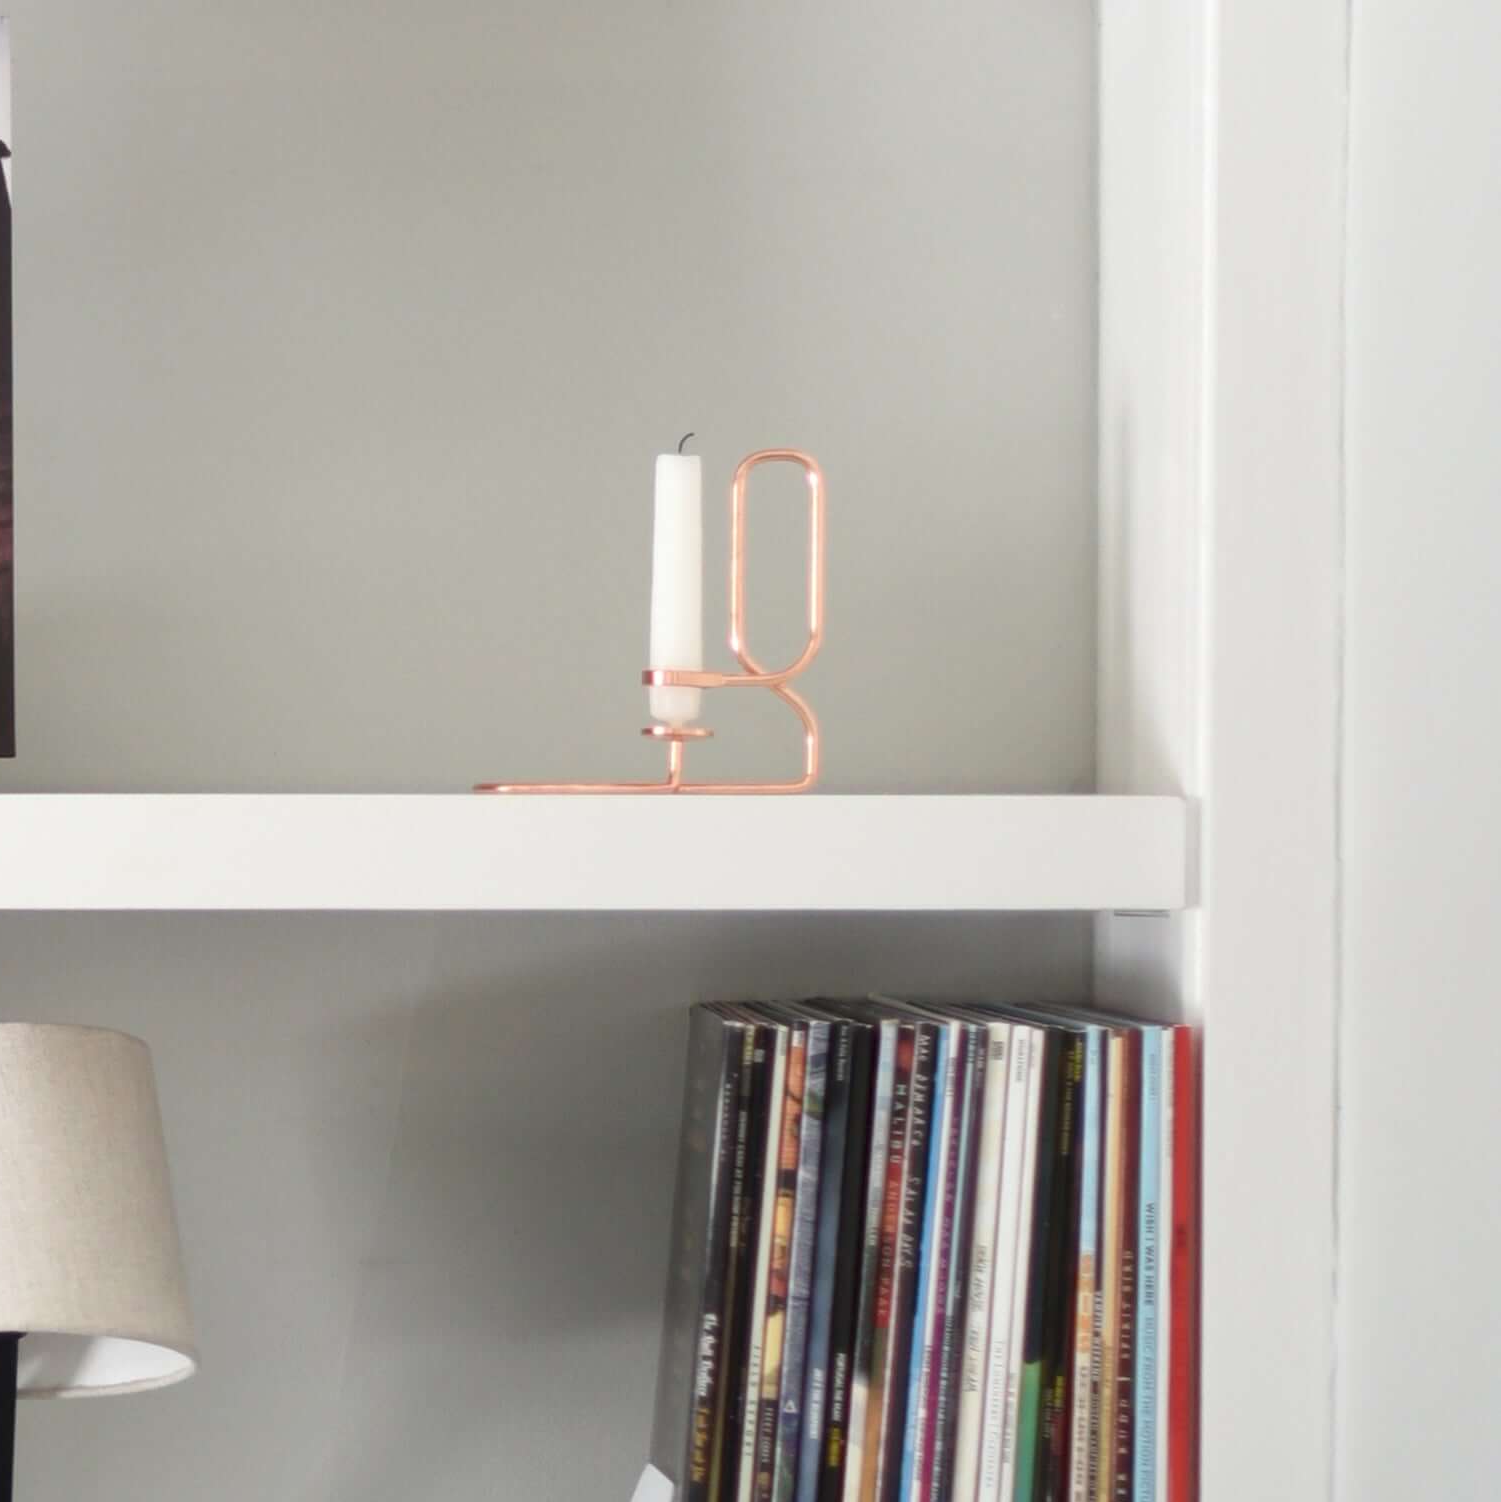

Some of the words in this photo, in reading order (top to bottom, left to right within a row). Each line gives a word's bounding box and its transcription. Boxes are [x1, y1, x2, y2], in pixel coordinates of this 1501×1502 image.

[889, 1084, 907, 1164] MALIBU
[880, 1180, 899, 1268] ANDERSON
[1145, 1203, 1155, 1234] WISH
[1145, 1246, 1154, 1271] WAS
[1144, 1275, 1154, 1307] HERE
[1143, 1357, 1153, 1390] FROM
[1142, 1395, 1152, 1415] THE
[1141, 1420, 1152, 1466] MOTION
